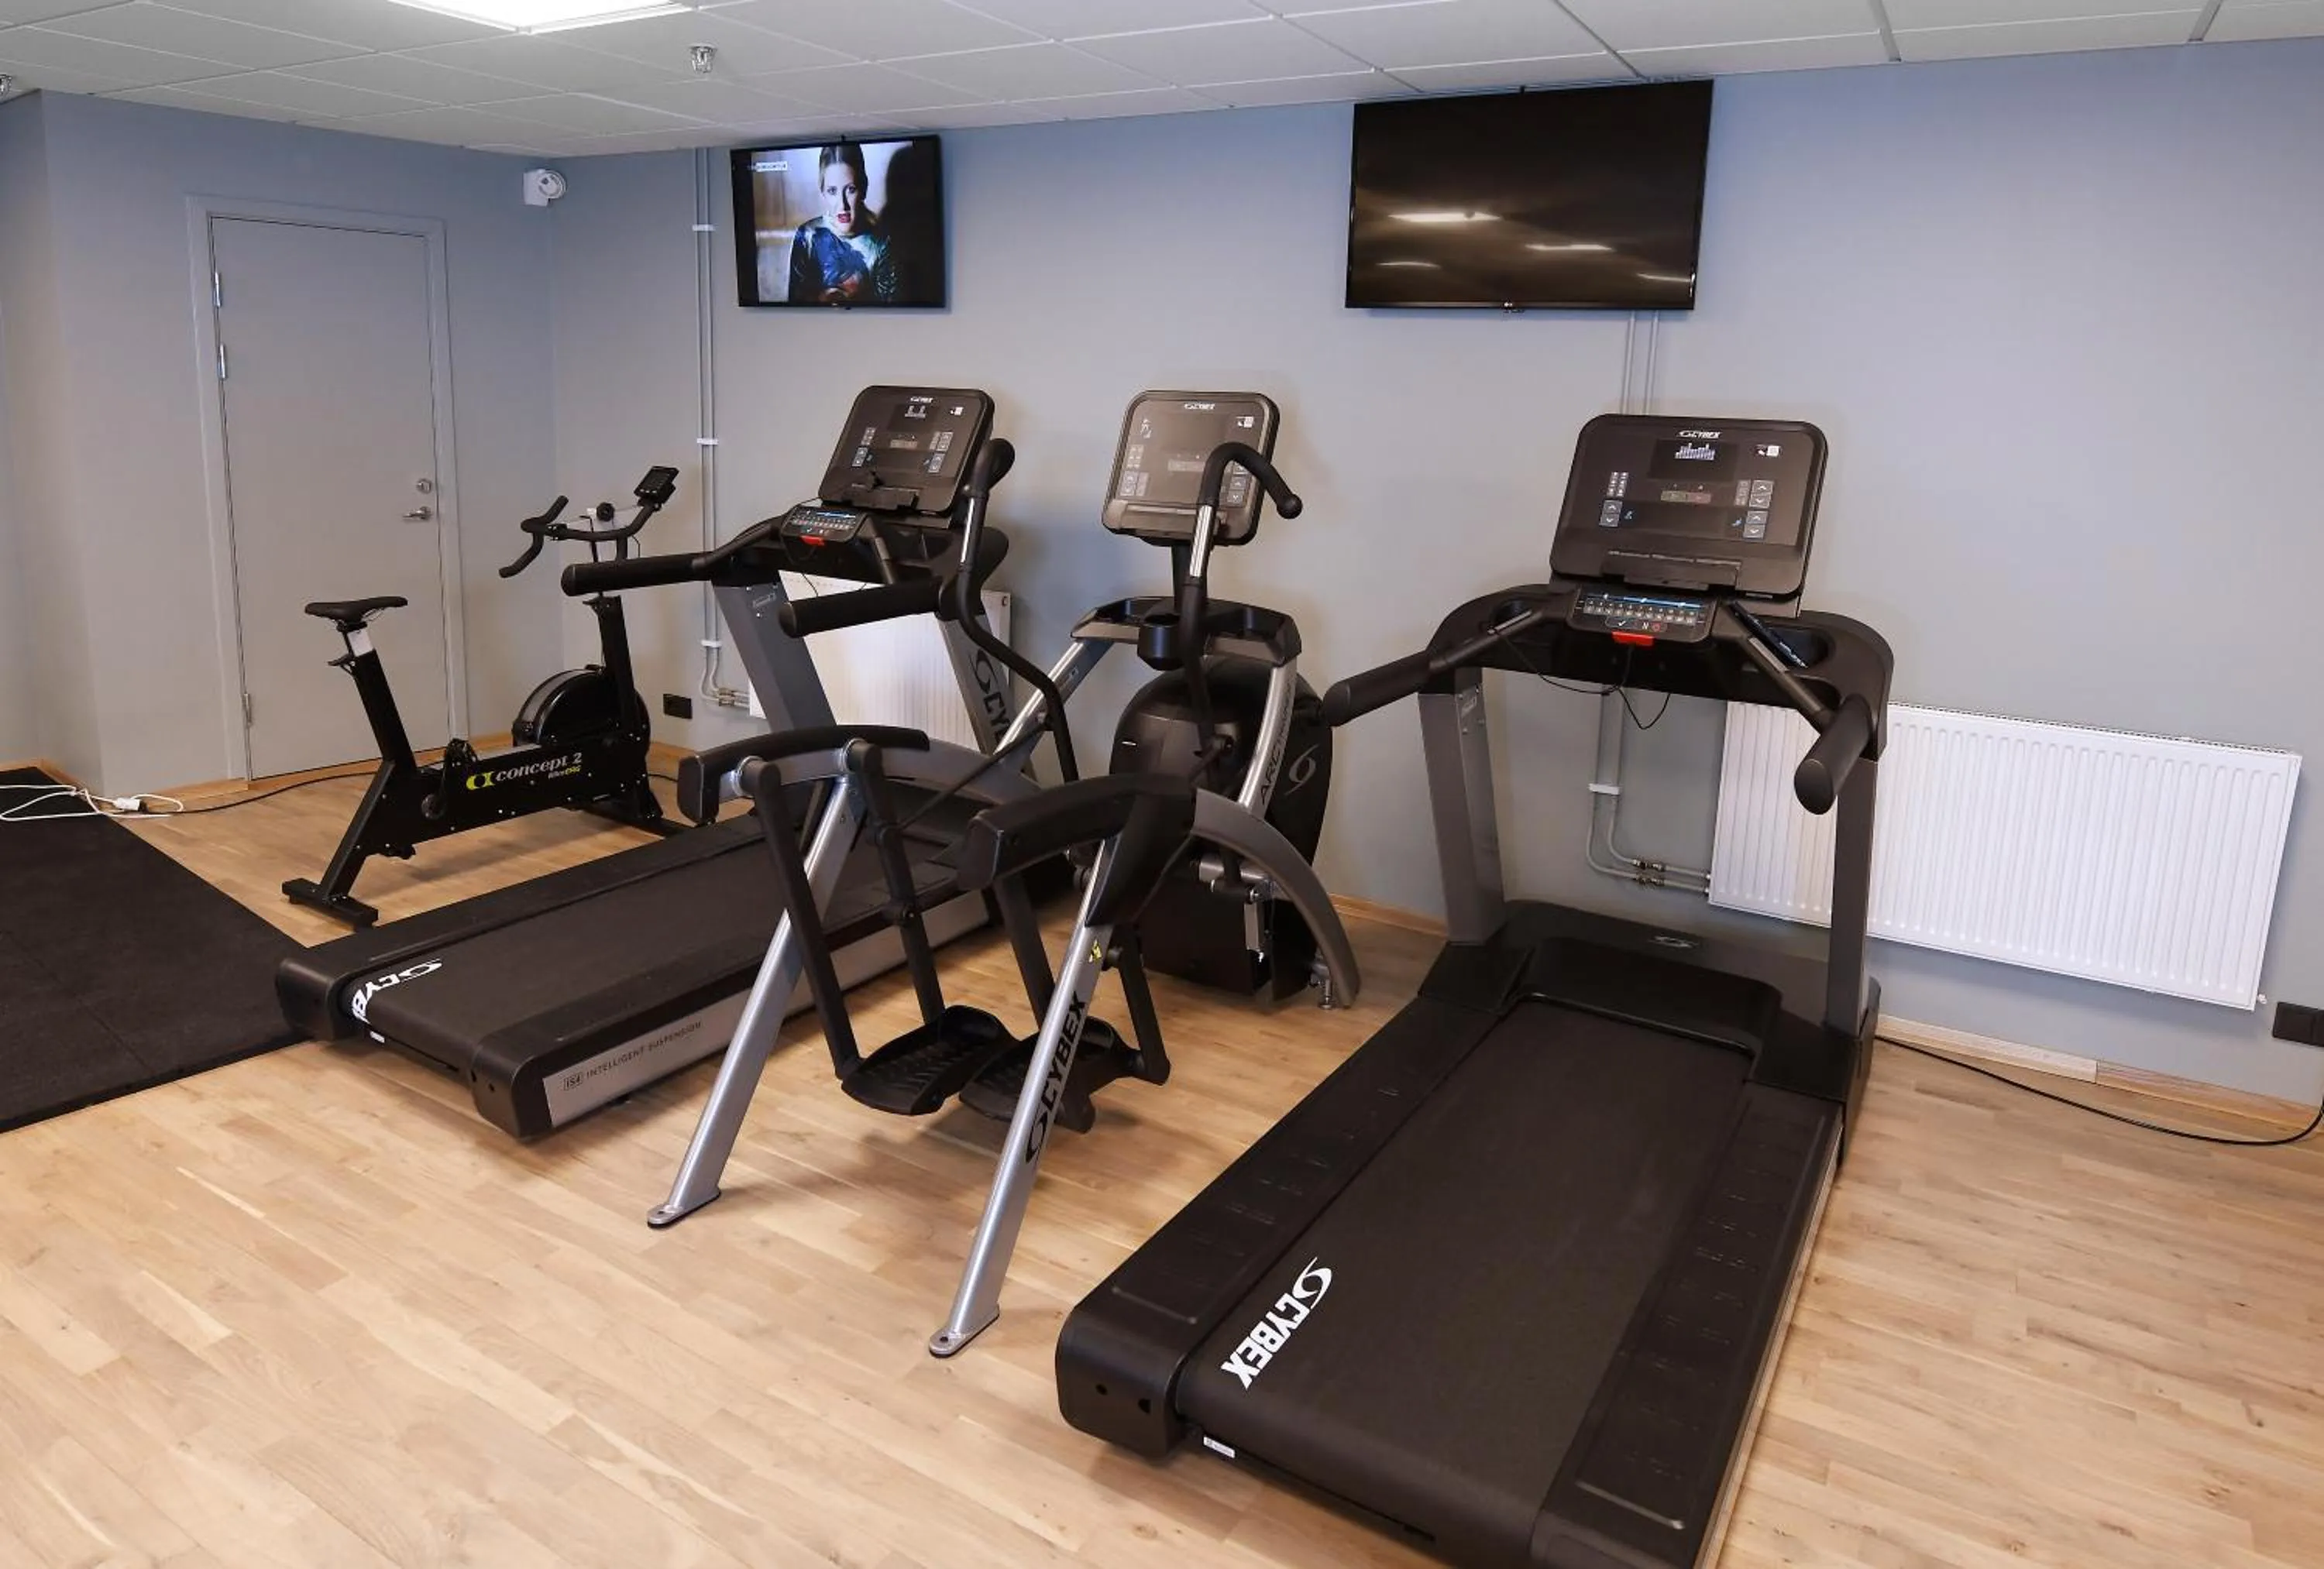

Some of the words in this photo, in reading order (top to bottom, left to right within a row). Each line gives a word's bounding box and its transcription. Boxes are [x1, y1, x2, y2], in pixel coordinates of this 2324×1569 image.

[496, 756, 567, 781] concept
[572, 752, 583, 764] 2
[586, 1047, 645, 1079] INTELLIGENT
[1041, 990, 1086, 1113] CYBEX
[1221, 1293, 1311, 1389] CYBEX
